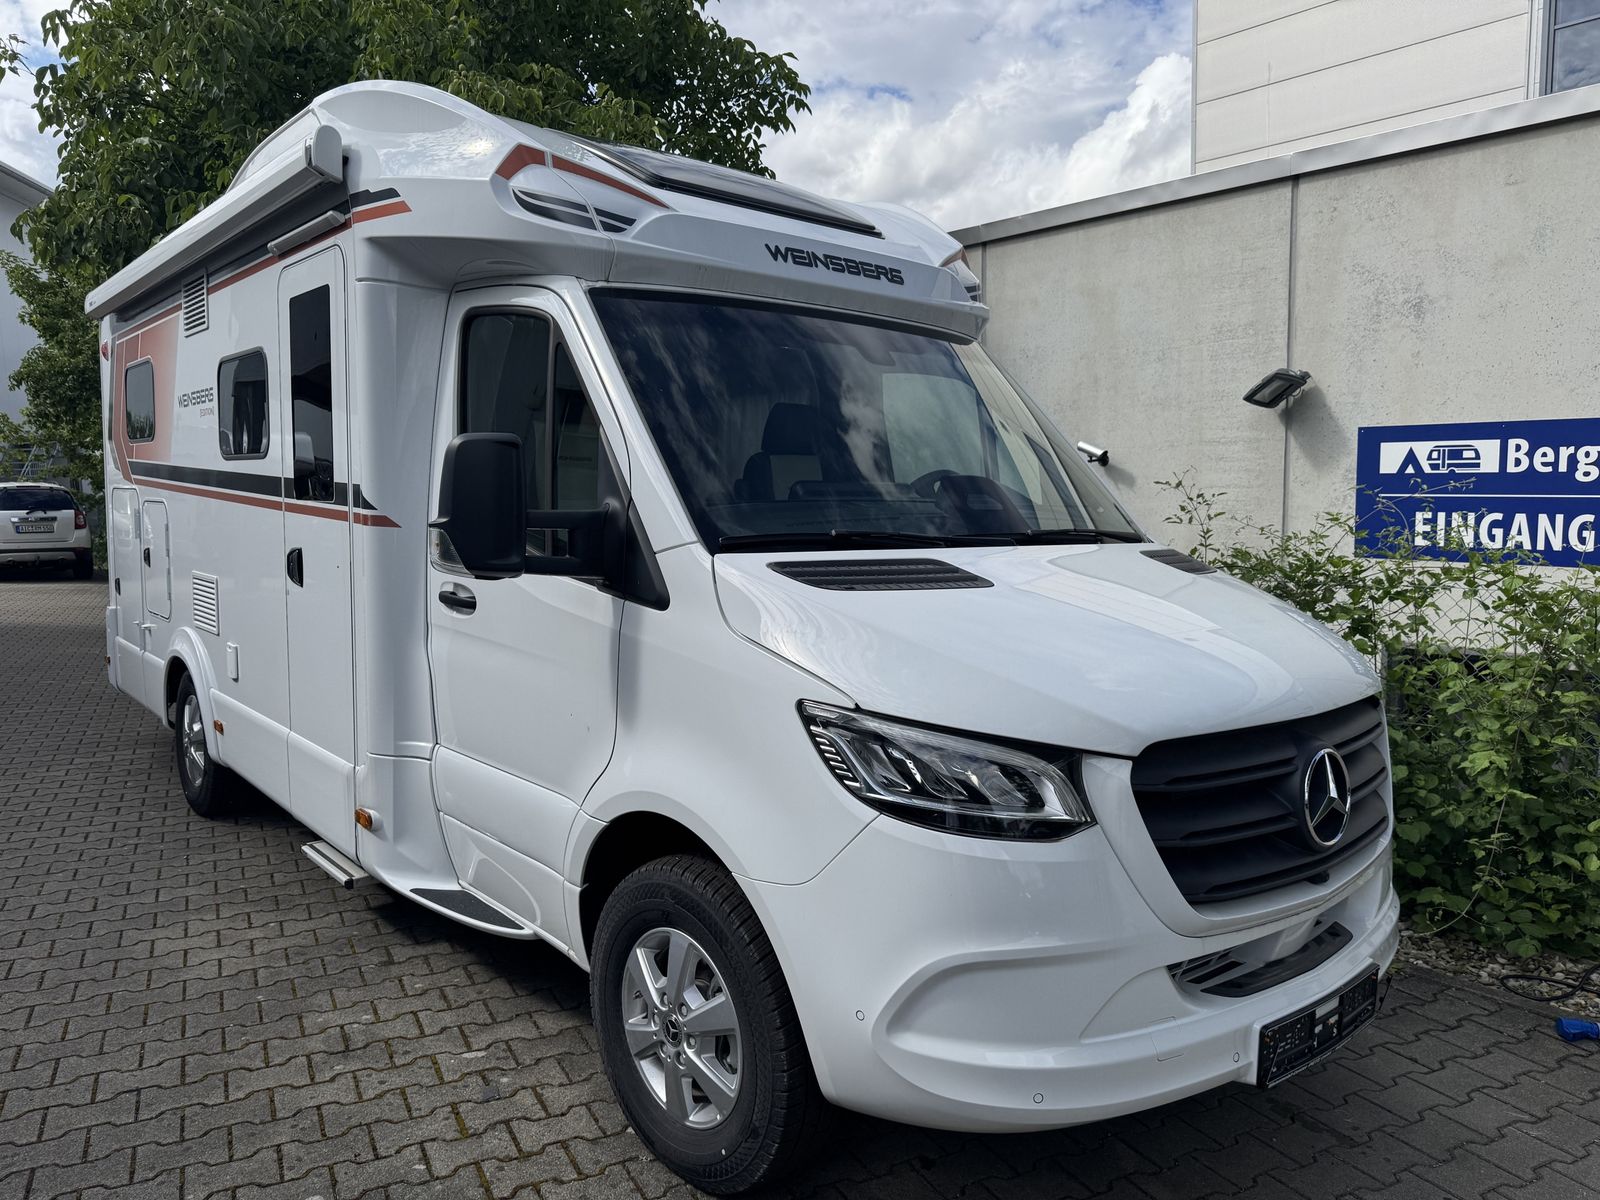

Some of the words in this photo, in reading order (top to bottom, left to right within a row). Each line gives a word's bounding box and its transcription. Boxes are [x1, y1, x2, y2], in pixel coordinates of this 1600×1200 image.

[764, 243, 904, 285] WEINSBERG
[1506, 438, 1600, 483] Berg
[1413, 511, 1596, 553] EINGANG
